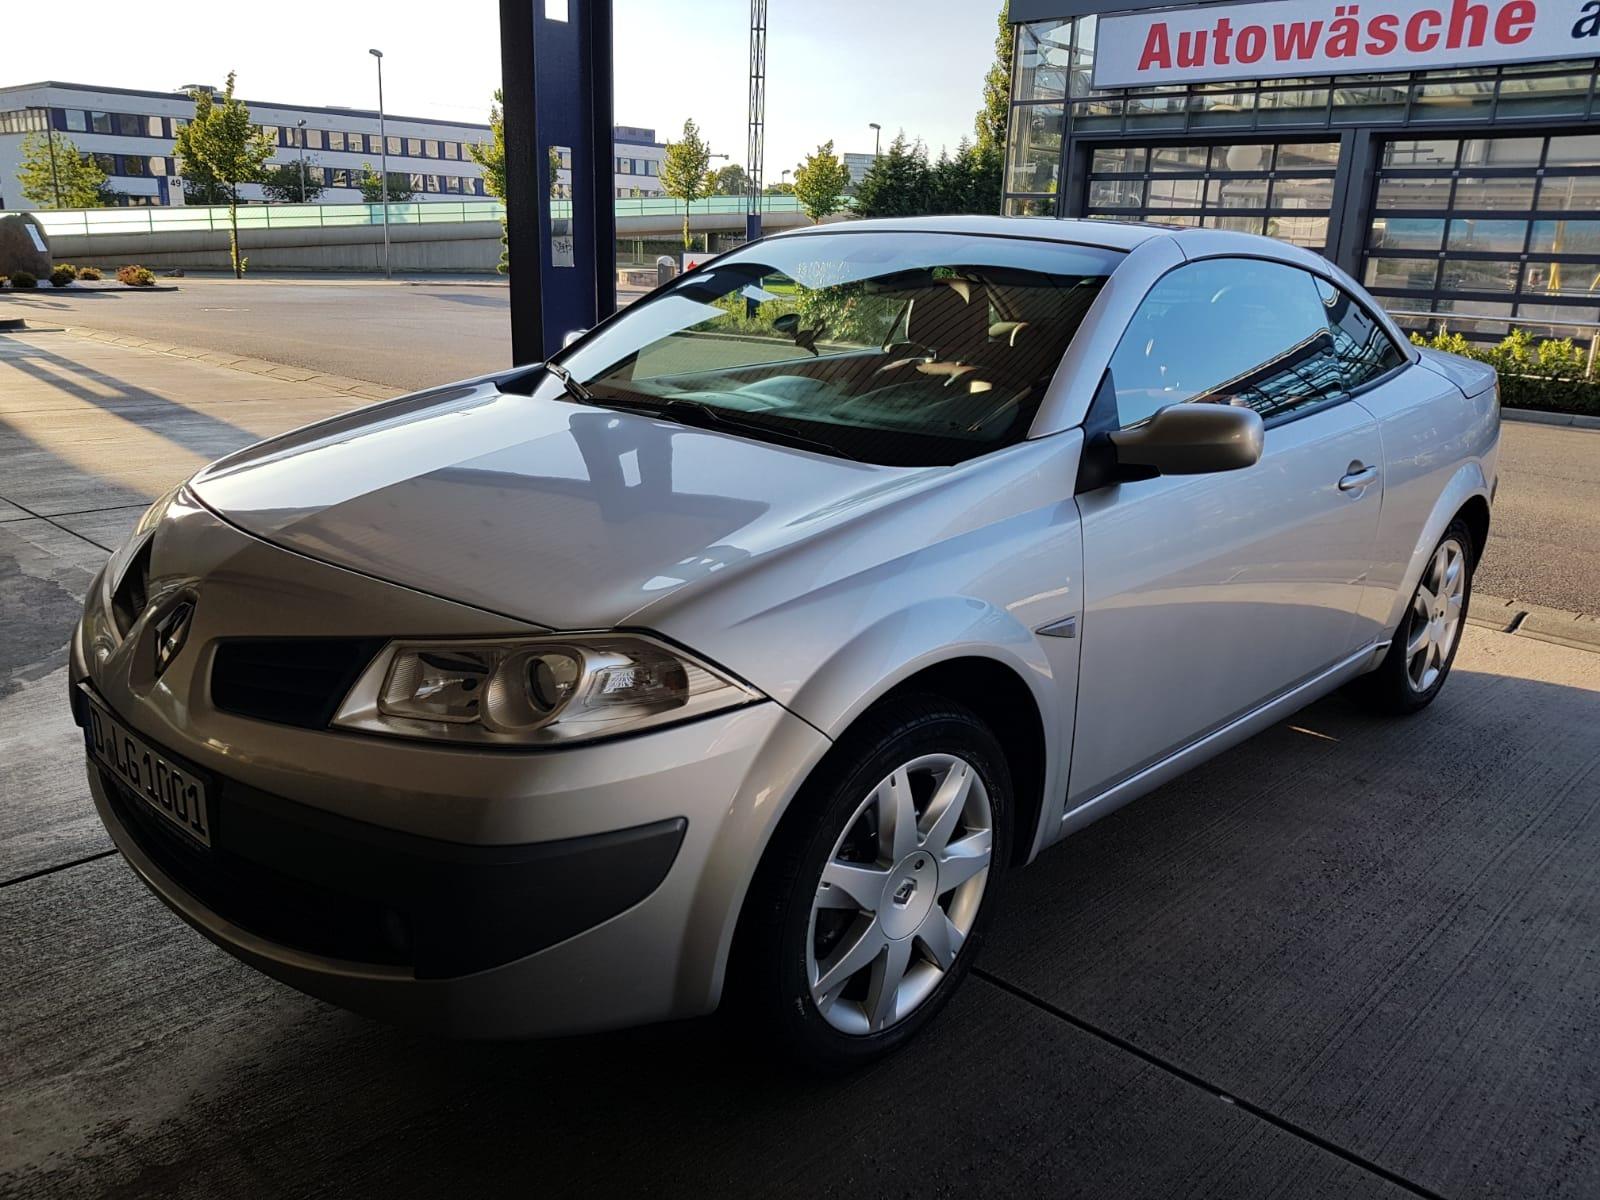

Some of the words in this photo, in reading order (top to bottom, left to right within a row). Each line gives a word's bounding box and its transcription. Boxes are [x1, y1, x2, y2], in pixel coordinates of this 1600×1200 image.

[1138, 0, 1536, 71] Autowäsche
[170, 179, 181, 187] 49
[112, 725, 141, 788] LG
[143, 751, 206, 837] 1001
